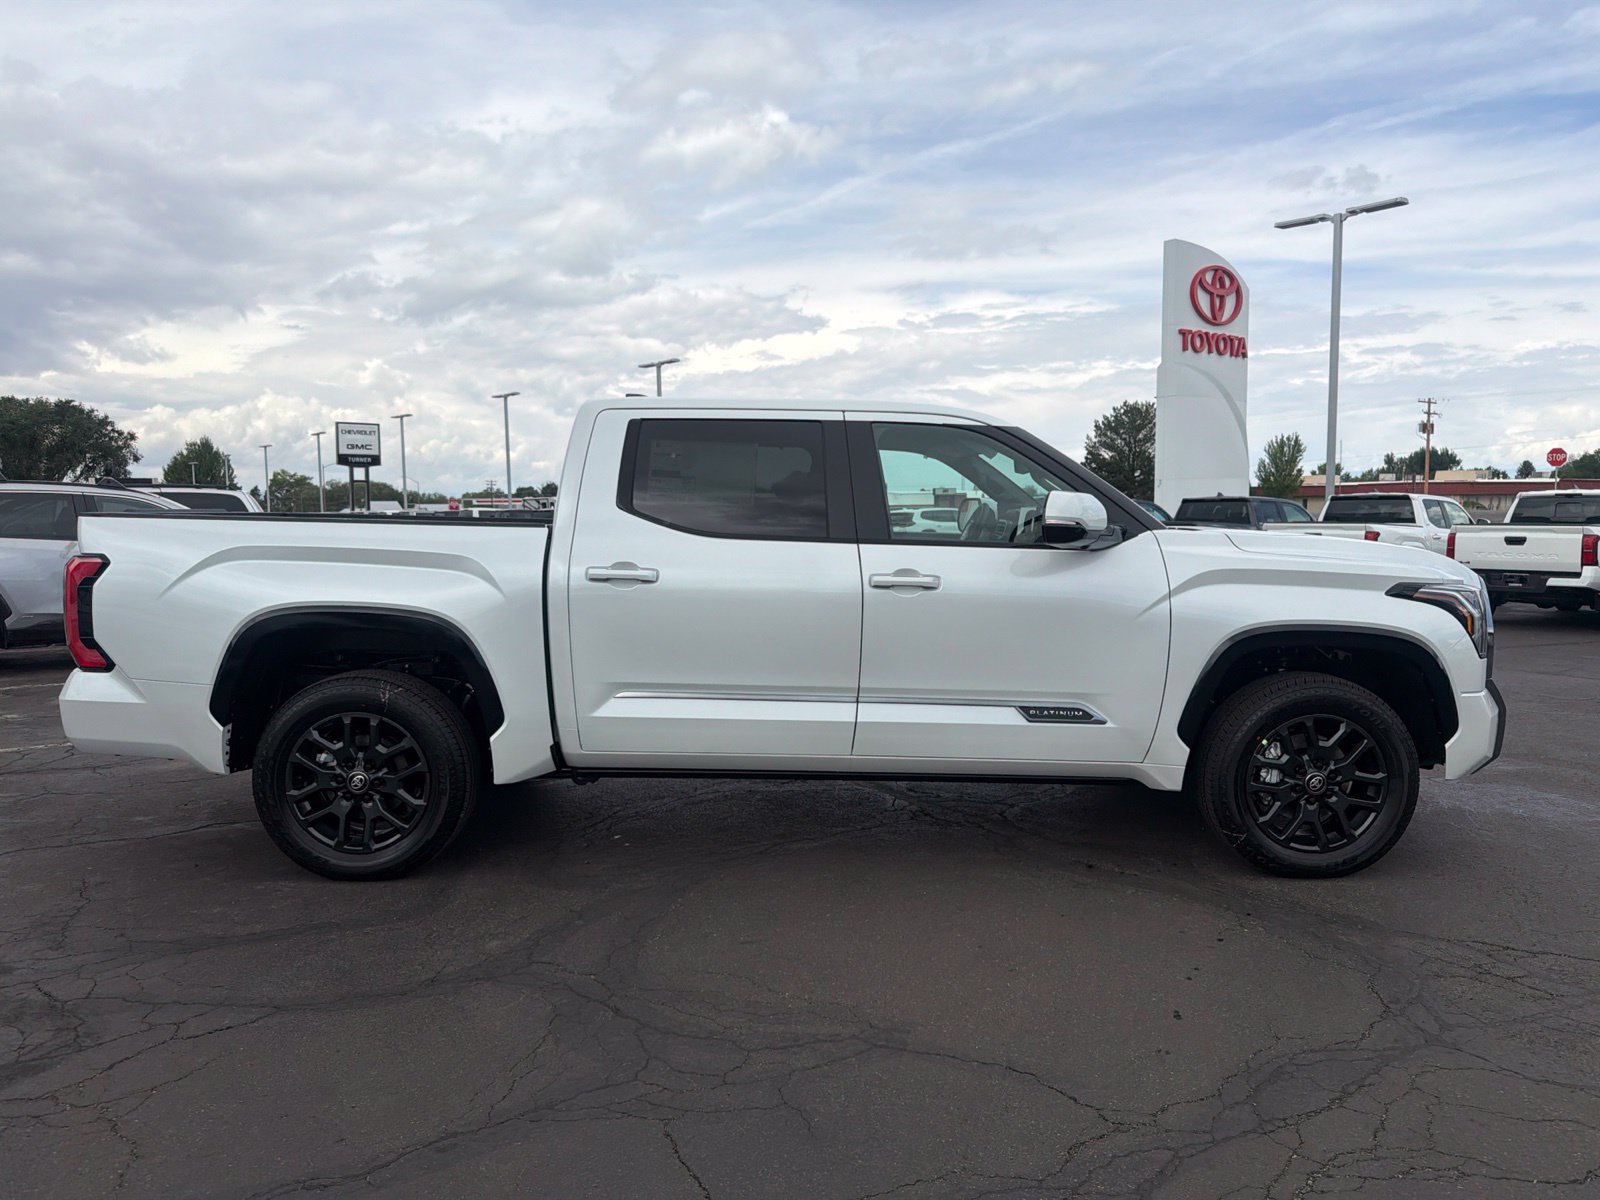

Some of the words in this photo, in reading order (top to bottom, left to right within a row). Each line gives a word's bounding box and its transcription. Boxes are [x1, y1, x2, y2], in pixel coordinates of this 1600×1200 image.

[1178, 328, 1248, 359] TOYOTA
[1547, 453, 1566, 462] STOP
[1473, 551, 1560, 560] TACOMA
